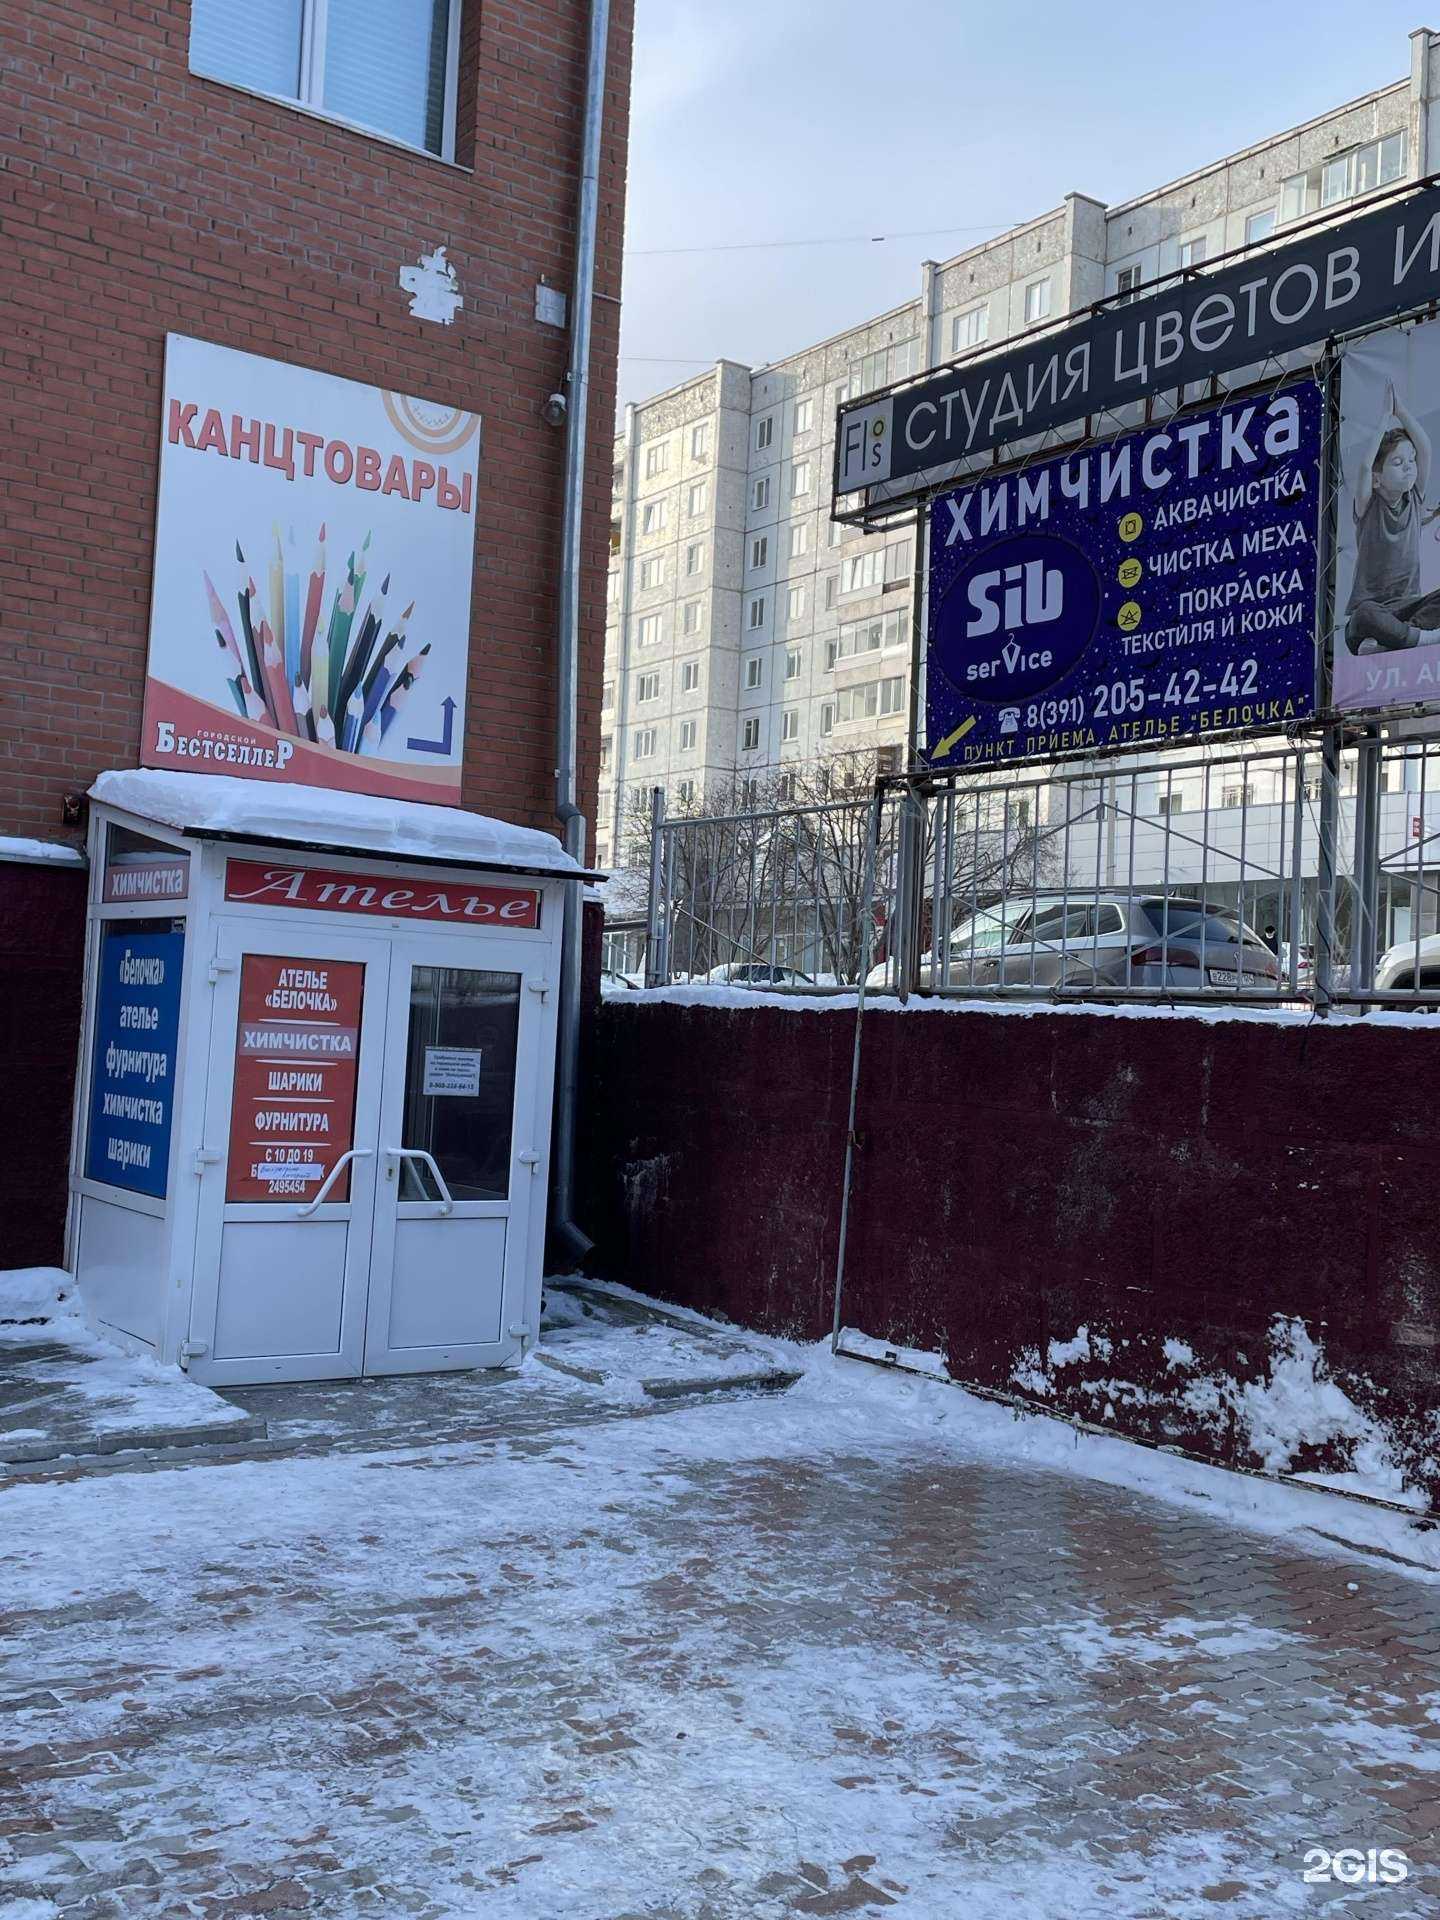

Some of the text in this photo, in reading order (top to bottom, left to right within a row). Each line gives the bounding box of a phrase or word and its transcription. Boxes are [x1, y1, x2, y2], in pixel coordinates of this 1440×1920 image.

[168, 398, 473, 514] КАНЦТОВАРЫ
[1153, 469, 1307, 531] АКВАЧИСТКА
[1149, 520, 1307, 577] ЧИСТКА МЕХА
[1179, 568, 1304, 616] ПОКРАСКА
[1122, 602, 1303, 655] ТЕКСТИЛЯ И КОЖИ
[1416, 660, 1440, 685] А
[1027, 658, 1258, 730] 8(391) 205-42-42
[964, 697, 1304, 761] ПУНКТ ПРИЕМА АТЕЛЬЕ "БЕЛОЧКА"
[228, 870, 531, 919] Ателье
[119, 949, 165, 986] «Белочка»
[278, 968, 328, 990] АТЕЛЬЕ
[119, 1004, 159, 1031] ателье
[264, 989, 338, 1012] «БЕЛОЧКА»
[243, 1031, 352, 1052] ХИМЧИСТКА
[105, 1041, 167, 1083] фурнитура
[268, 1071, 323, 1093] ШАРИКИ
[102, 1092, 163, 1125] химчистка
[254, 1111, 329, 1132] ФУРНИТУРА
[107, 1137, 151, 1170] шарики
[265, 1148, 314, 1164] С 10 ДО 19
